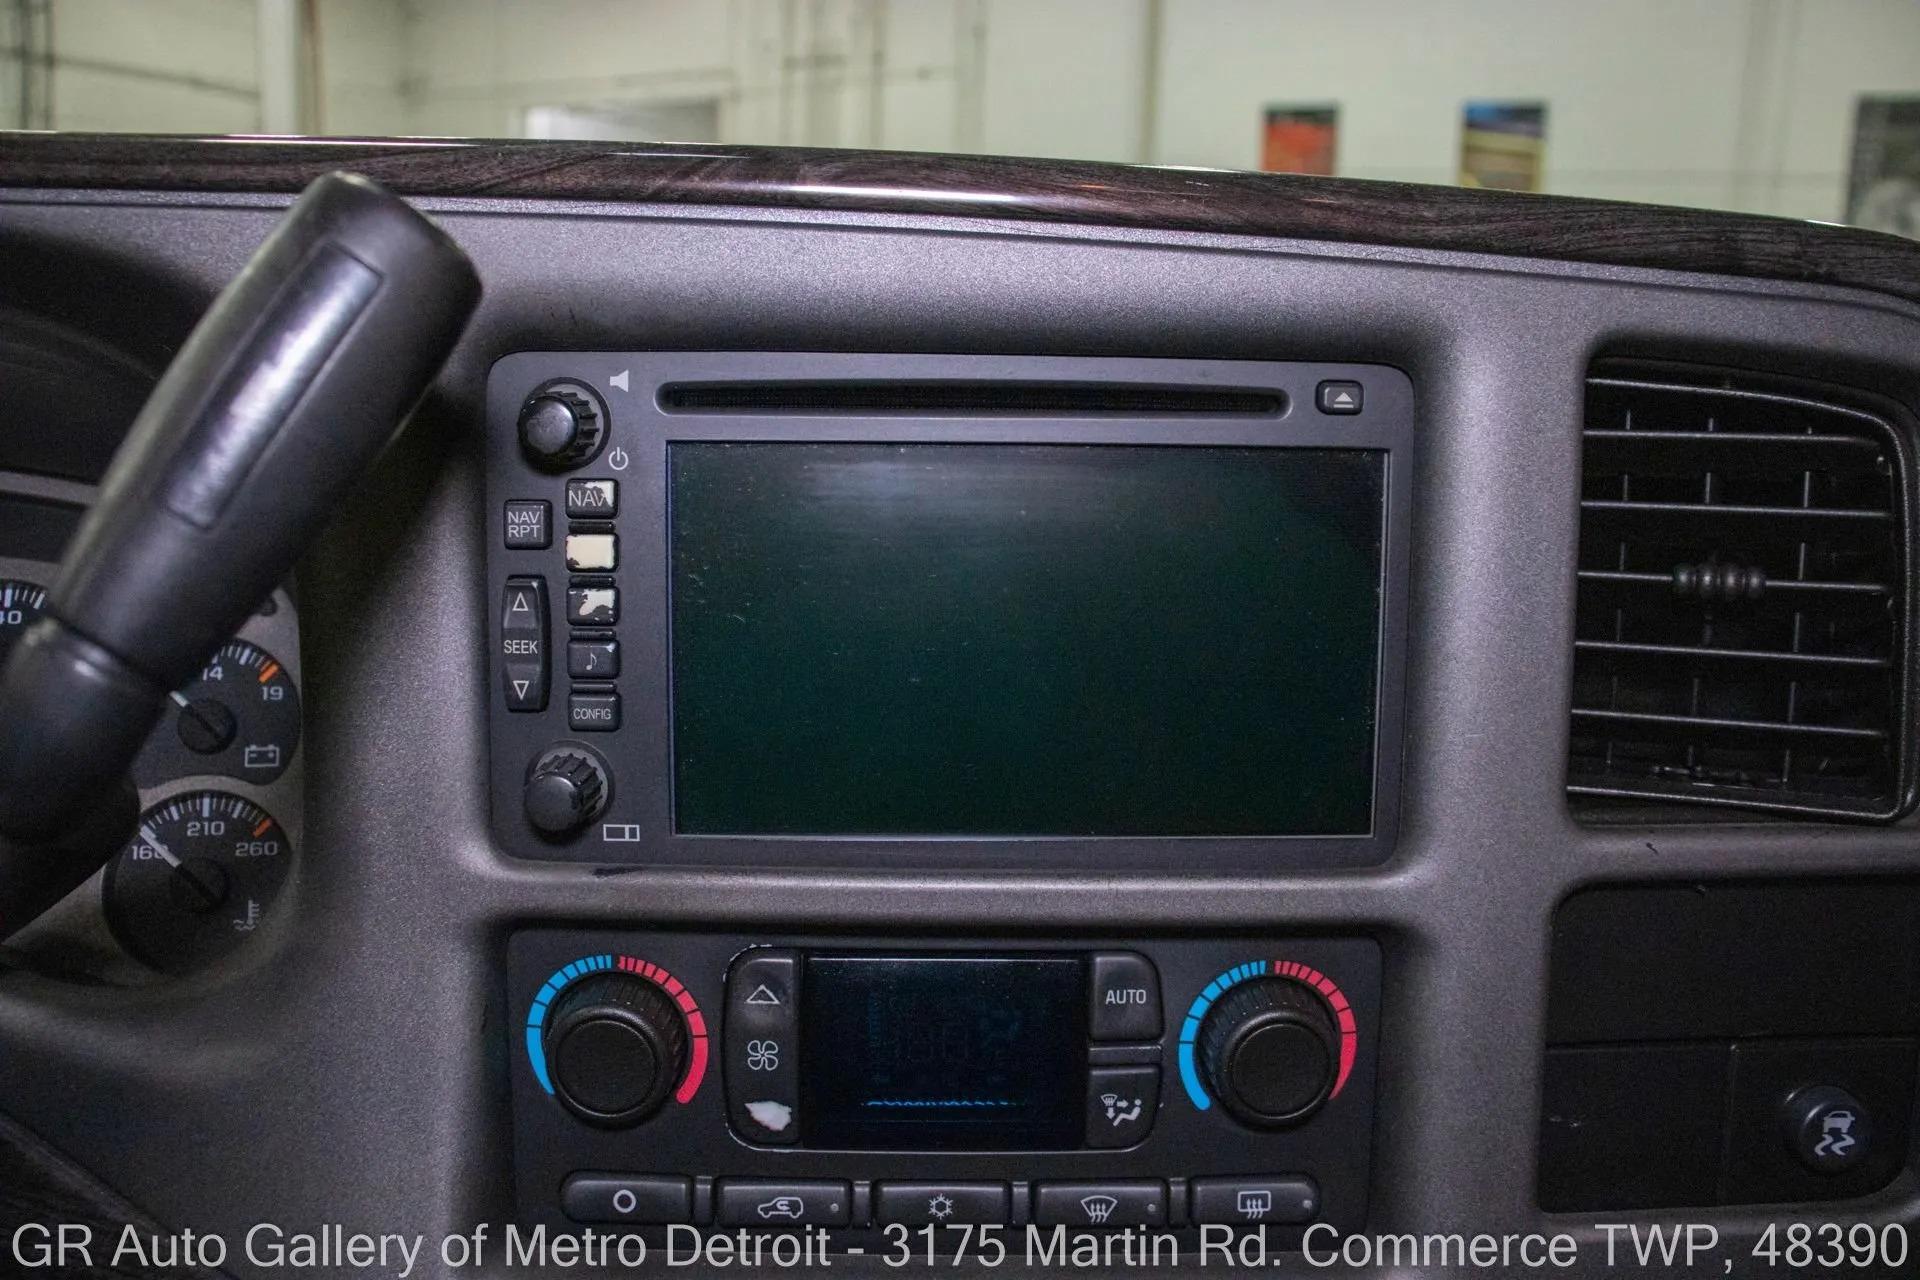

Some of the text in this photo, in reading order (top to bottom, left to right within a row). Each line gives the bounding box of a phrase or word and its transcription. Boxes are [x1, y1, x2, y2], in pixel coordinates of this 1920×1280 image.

[508, 511, 540, 524] NAV
[508, 525, 540, 538] RPT
[503, 639, 538, 655] SEEK
[202, 665, 224, 681] 14
[261, 685, 284, 701] 19
[573, 708, 612, 720] CONFIG
[186, 820, 225, 837] 210
[234, 841, 278, 857] 260
[1105, 989, 1147, 1005] AUTO
